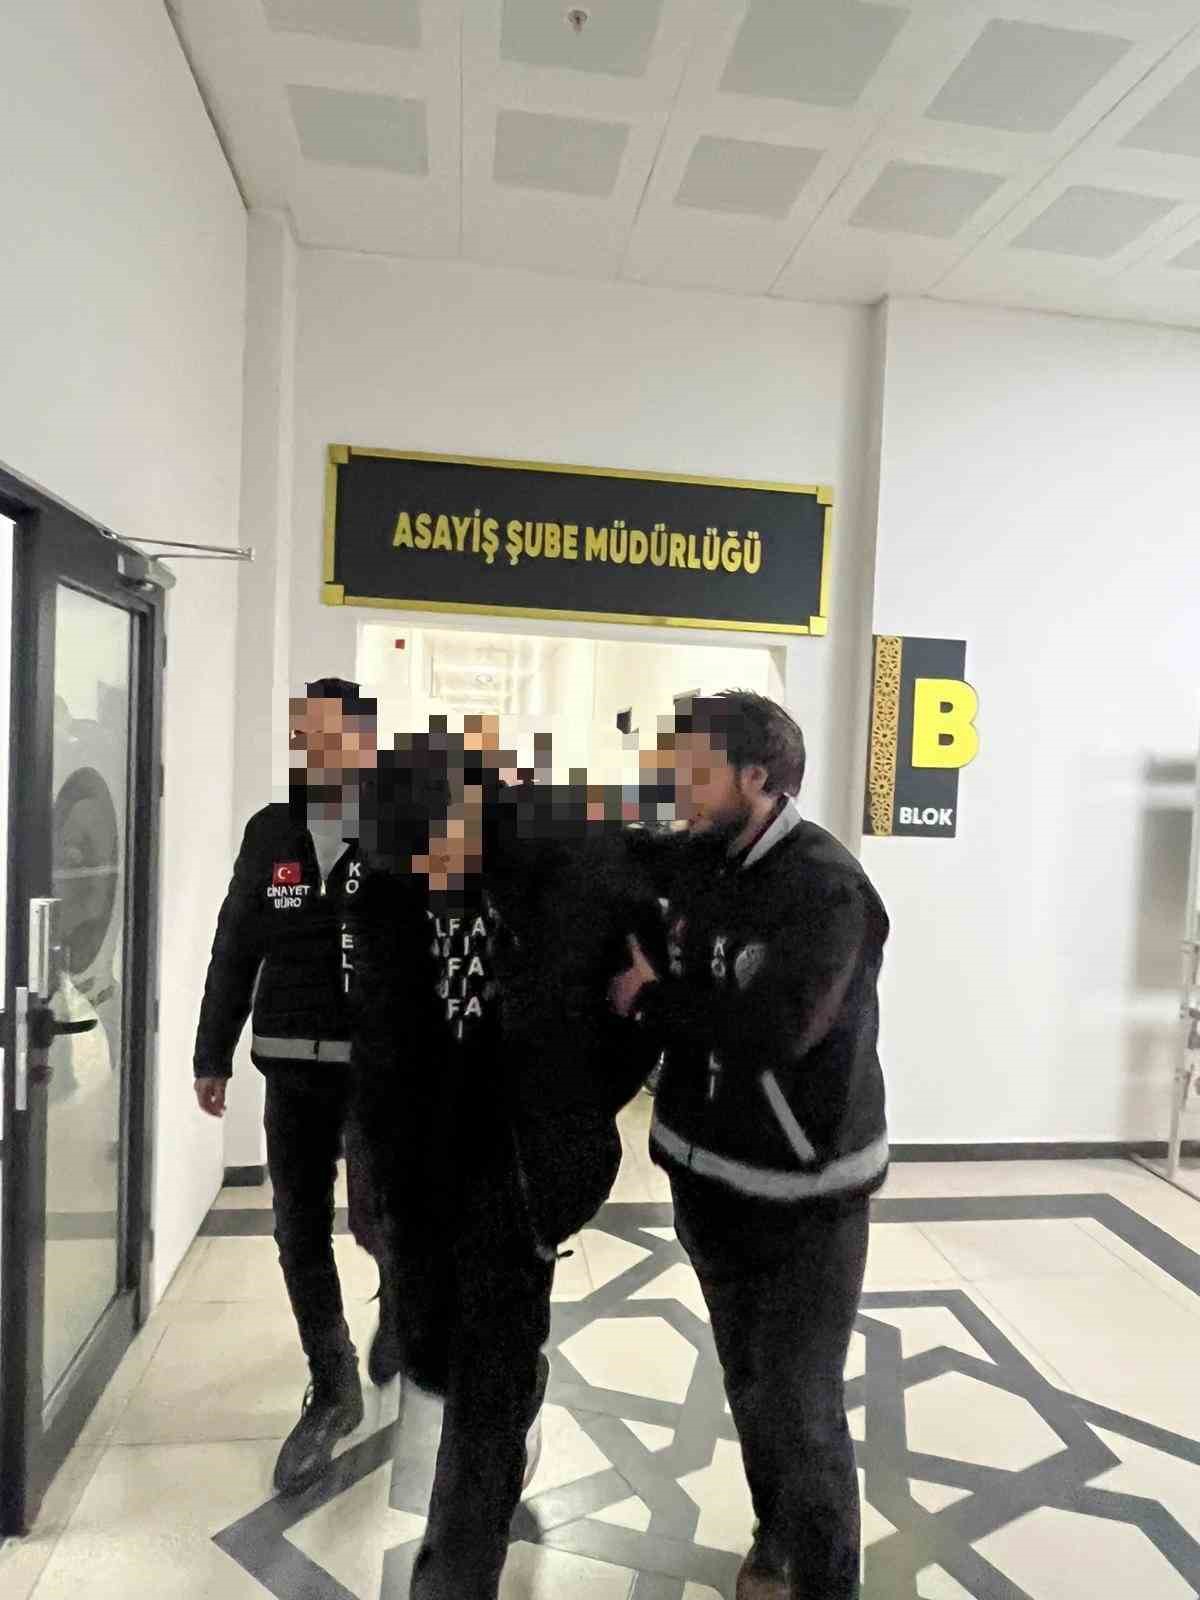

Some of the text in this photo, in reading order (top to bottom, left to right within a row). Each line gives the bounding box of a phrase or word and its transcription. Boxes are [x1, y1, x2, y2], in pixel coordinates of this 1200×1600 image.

[393, 508, 762, 574] ASAYİŞ ŞUBE MÜDÜRLÜĞÜ
[912, 678, 980, 768] B
[899, 806, 954, 826] BLOK
